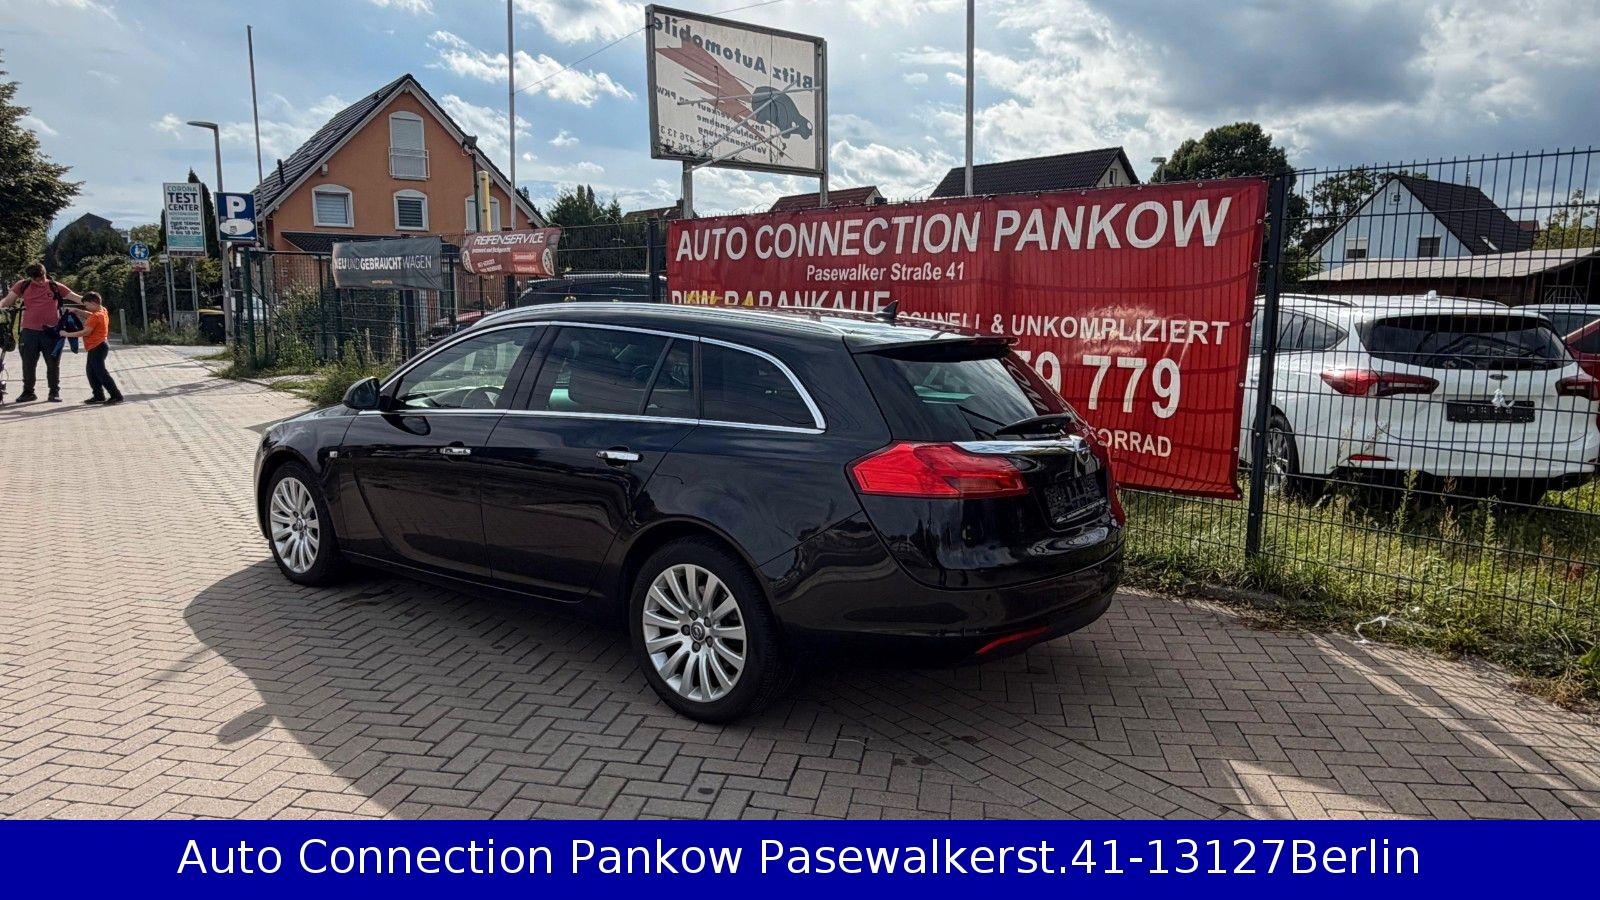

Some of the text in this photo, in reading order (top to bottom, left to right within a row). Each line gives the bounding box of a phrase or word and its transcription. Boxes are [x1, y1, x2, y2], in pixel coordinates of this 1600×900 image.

[167, 192, 198, 204] TEST
[168, 203, 200, 211] CENTER
[225, 195, 247, 219] P
[473, 232, 544, 245] REIFENSERVICE
[675, 197, 1232, 262] AUTO CONNECTION PANKOW
[806, 261, 965, 281] Pasewalker Straße 41
[990, 314, 1004, 335] &
[1012, 314, 1231, 345] UNKOMPLIZIERT
[1082, 354, 1181, 418] 779
[1095, 428, 1172, 457] ORRAD
